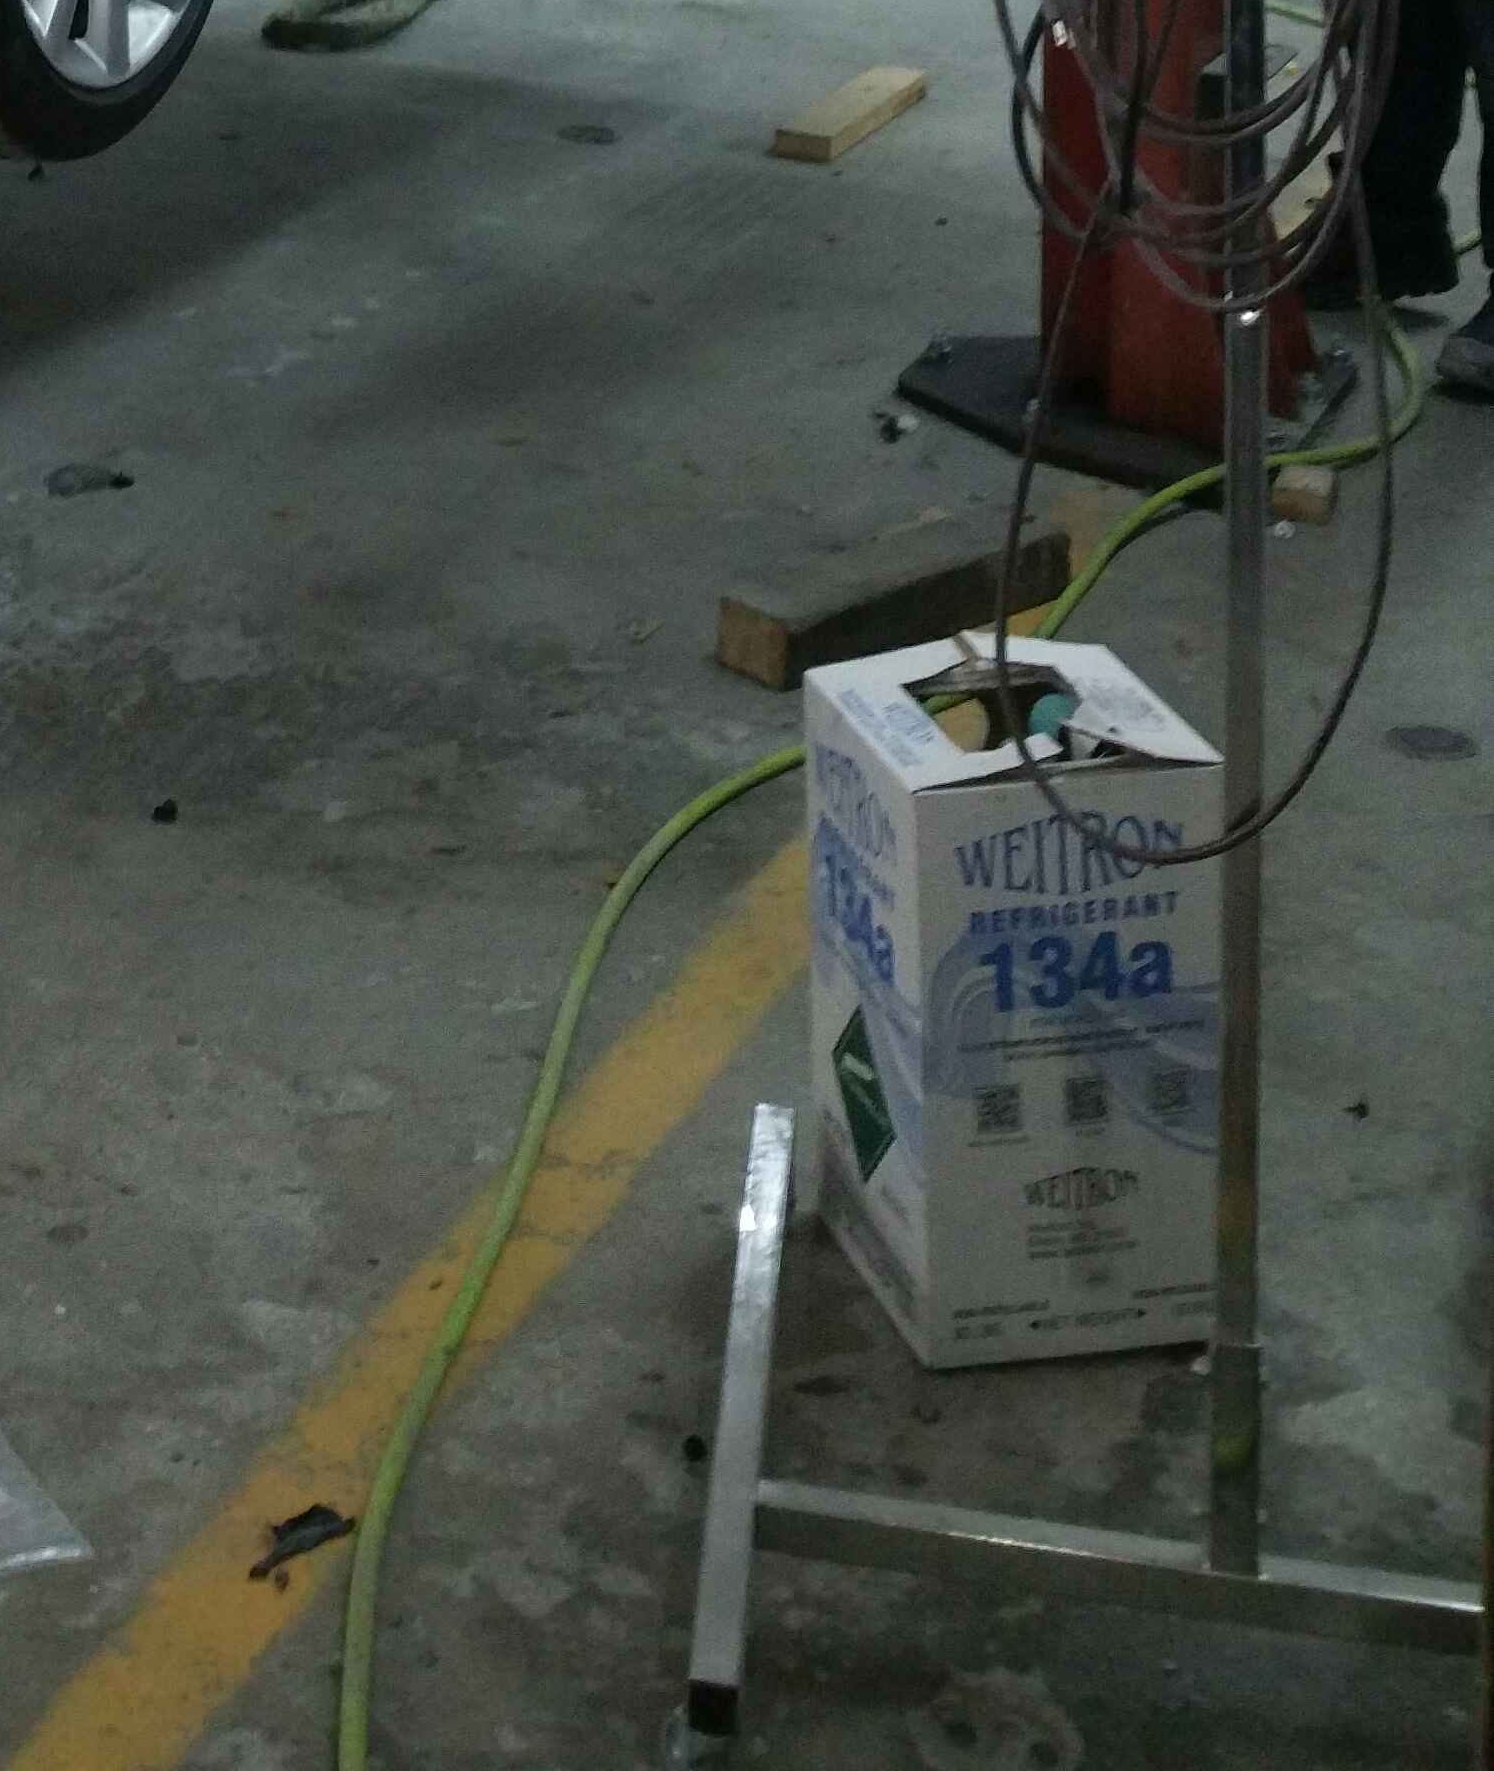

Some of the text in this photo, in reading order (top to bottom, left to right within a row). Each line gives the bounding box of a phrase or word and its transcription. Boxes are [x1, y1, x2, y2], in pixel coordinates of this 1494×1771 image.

[953, 810, 1185, 896] WEITRON
[969, 890, 1180, 934] REFRIGERANT
[978, 930, 1173, 1013] 134a
